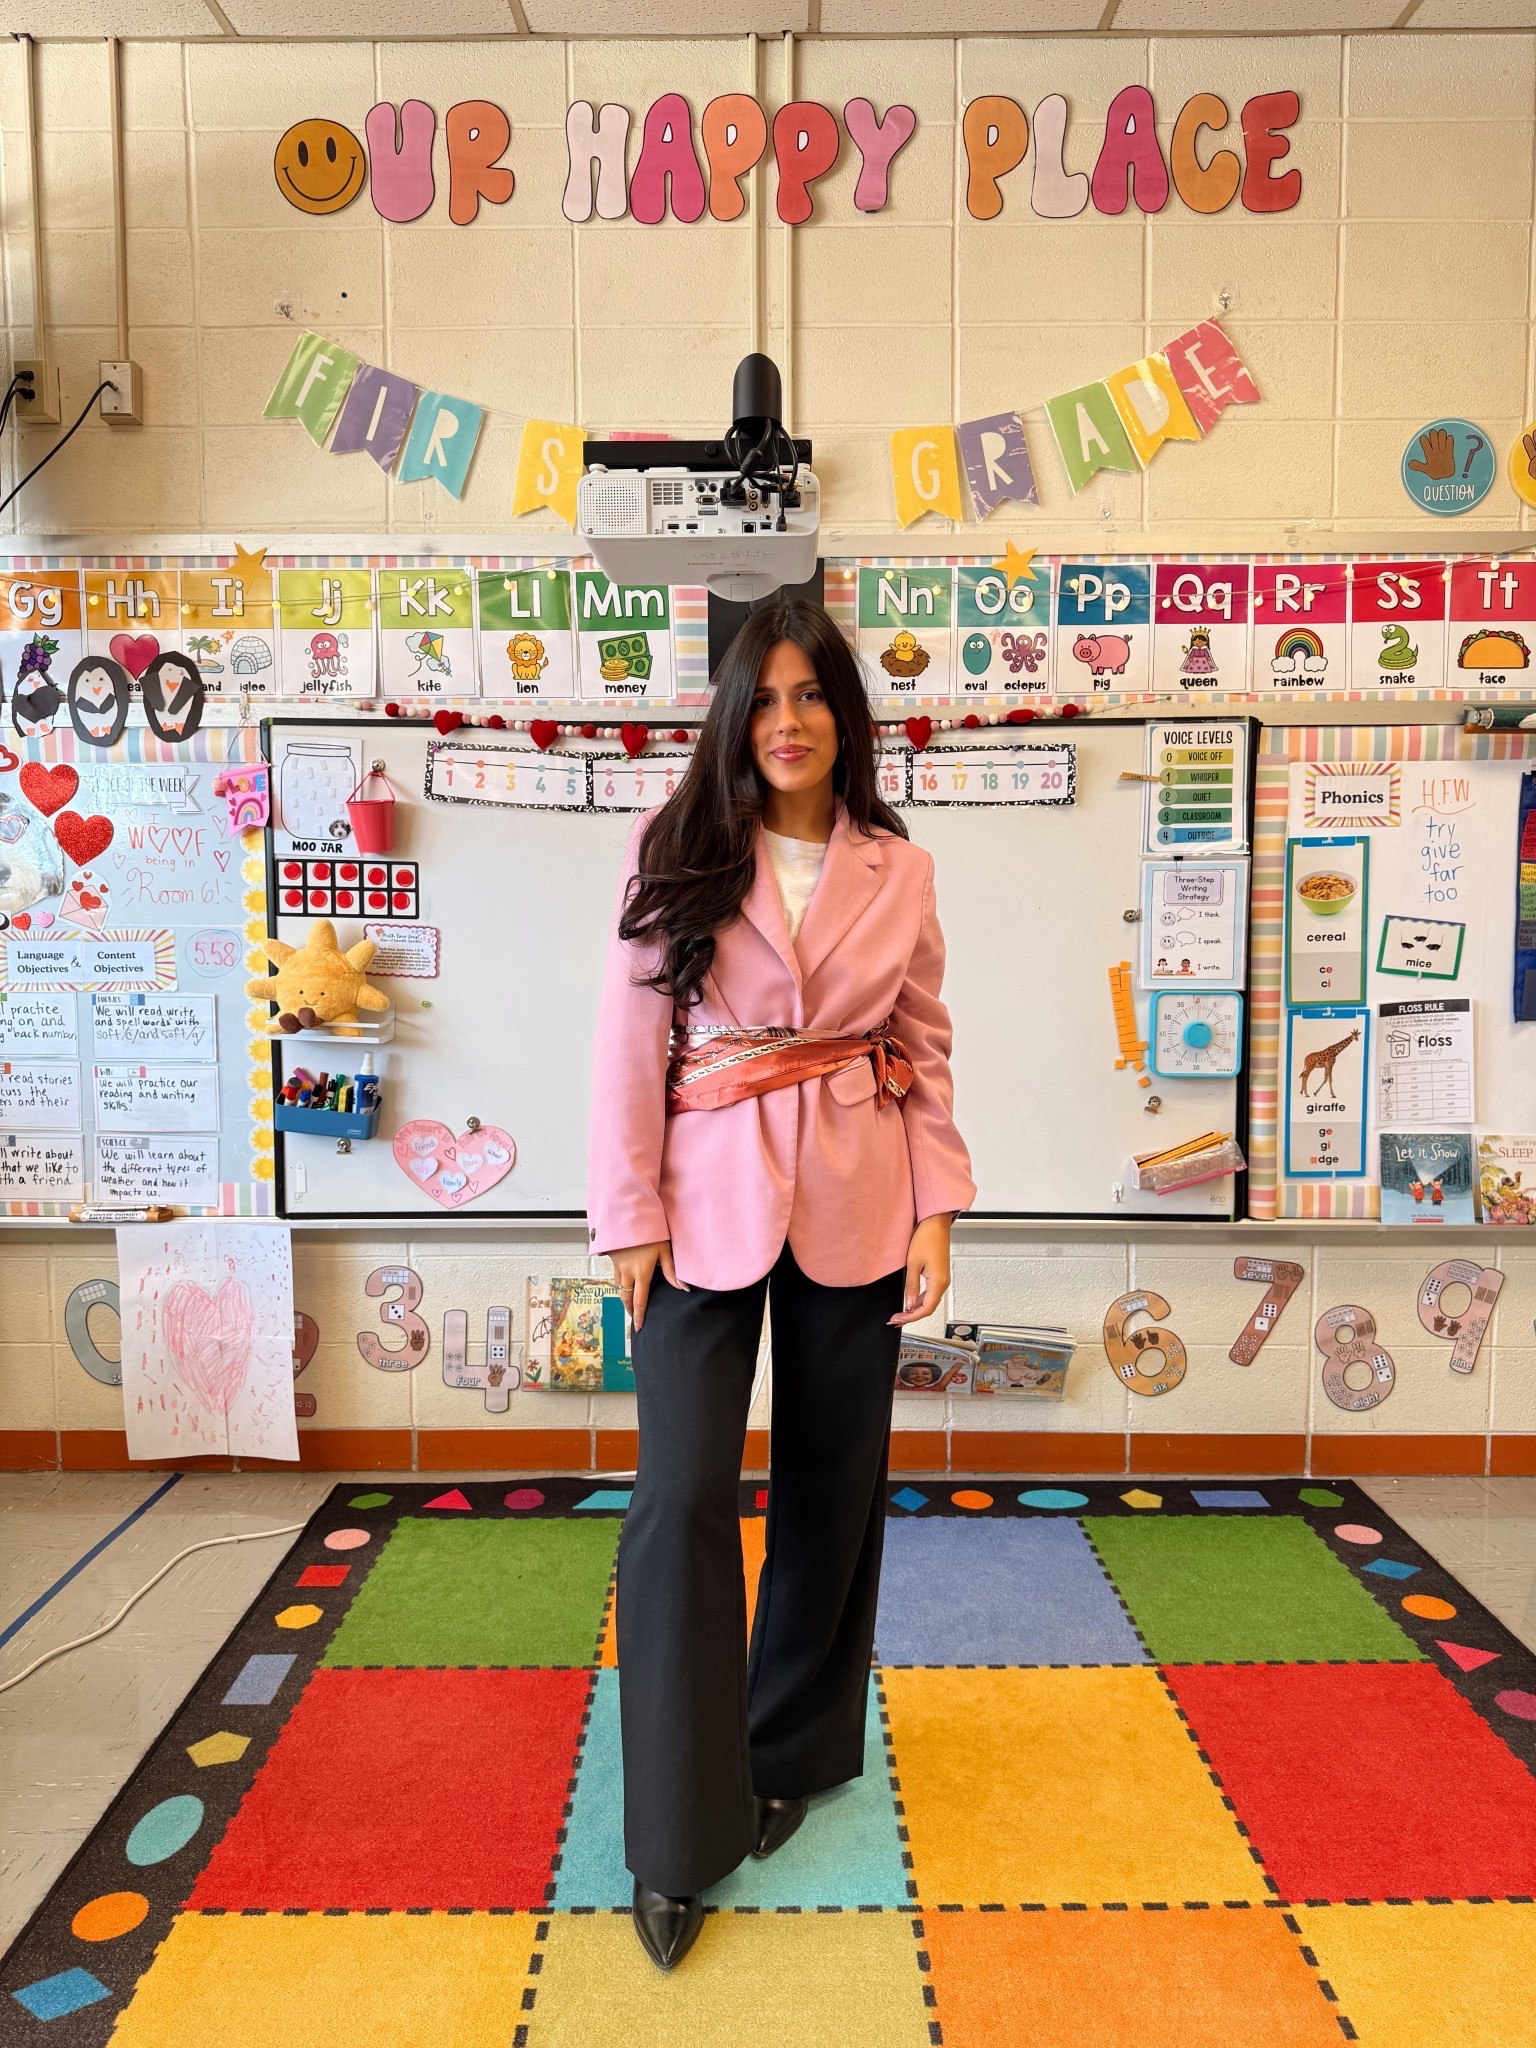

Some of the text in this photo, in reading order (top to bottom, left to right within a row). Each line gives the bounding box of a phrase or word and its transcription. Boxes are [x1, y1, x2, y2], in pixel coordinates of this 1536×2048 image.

[562, 92, 917, 226] HAPPY
[962, 85, 1302, 221] PLACE
[911, 341, 1232, 501] GRADE
[1423, 484, 1475, 501] QUESTION
[399, 577, 455, 617] Kk
[877, 576, 935, 616] Nn
[974, 575, 1035, 616] Oo
[1171, 573, 1233, 621] Qq
[1274, 573, 1327, 613] Rr
[1376, 571, 1423, 610] Ss
[1477, 571, 1519, 610] Tt
[8, 581, 63, 627] Gg
[106, 580, 161, 618] Hh
[211, 578, 244, 617] Ii
[312, 578, 343, 626] Jj
[510, 579, 542, 619] Ll
[583, 579, 665, 619] Mm
[1076, 573, 1132, 622] Pp
[891, 679, 917, 691] nest
[1093, 678, 1111, 691] pig
[1179, 676, 1218, 689] queen
[1273, 675, 1325, 687] rainbow
[1379, 673, 1416, 685] snake
[1479, 672, 1506, 685] taco
[239, 681, 266, 693] igloo
[300, 681, 353, 694] jellyfish
[417, 680, 442, 692] kite
[516, 681, 539, 694] lion
[604, 683, 647, 696] money
[964, 680, 1047, 692] oval octopus
[1164, 730, 1233, 744] VOICE LEVELS
[1188, 751, 1223, 761] VOICE OFF
[446, 770, 577, 795] 1 2 3 4 5
[881, 775, 899, 792] 15
[920, 771, 1063, 791] 16 17 18 19 20
[1190, 772, 1220, 782] WHISPER
[159, 777, 185, 793] WEEK
[226, 774, 267, 794] LOVE
[604, 780, 675, 797] 6 7 8
[1192, 793, 1212, 801] QUIET
[1321, 791, 1384, 805] Phonics
[1182, 812, 1222, 820] CLASSROOM
[1426, 816, 1456, 839] try
[1187, 831, 1215, 840] OUTSIDE
[292, 841, 343, 854] MOO JAR
[1421, 841, 1461, 871] give
[146, 856, 195, 873] being in
[1429, 863, 1465, 883] far
[127, 867, 194, 904] Room
[1173, 876, 1215, 884] Three-Step
[1180, 884, 1208, 893] Writing
[1424, 884, 1458, 903] too
[1177, 893, 1210, 902] Strategy
[1203, 938, 1222, 946] speak.
[1306, 931, 1346, 942] cereal
[17, 951, 65, 961] Language
[97, 951, 137, 960] Content
[194, 941, 236, 967] 5.58
[17, 963, 69, 974] Objectives
[93, 963, 144, 974] Objectives
[1406, 958, 1432, 968] mice
[1319, 966, 1333, 974] ce
[1321, 979, 1331, 988] ci
[11, 1002, 59, 1019] practice
[95, 1005, 135, 1016] We will
[1399, 1003, 1445, 1014] FLOSS RULE
[18, 1015, 66, 1027] on and
[95, 1016, 200, 1029] and spell words with
[14, 1029, 40, 1038] back
[97, 1028, 121, 1040] soft
[1417, 1035, 1453, 1048] floss
[9, 1072, 72, 1085] read stories
[139, 1077, 176, 1090] practice
[30, 1086, 47, 1097] the
[99, 1088, 195, 1103] reading and writing
[18, 1097, 36, 1106] and
[40, 1096, 70, 1107] their
[1306, 1103, 1346, 1114] giraffe
[412, 1122, 443, 1133] heart
[1319, 1128, 1333, 1137] ge
[11, 1145, 74, 1160] write about
[1320, 1142, 1331, 1152] gi
[1395, 1143, 1457, 1162] Let Snow
[1499, 1147, 1533, 1158] SLEEP
[101, 1149, 206, 1161] We will learn about
[1, 1160, 63, 1173] that like
[102, 1161, 190, 1175] the different types
[32, 1172, 73, 1186] friend
[101, 1175, 176, 1187] weather and how
[146, 1189, 161, 1197] us.
[1242, 1270, 1274, 1282] seven
[357, 1265, 431, 1372] 3
[1103, 1290, 1187, 1396] 6
[378, 1356, 409, 1369] three
[443, 1306, 521, 1413] 4
[1450, 1357, 1474, 1370] nine
[456, 1375, 482, 1387] four
[1153, 1381, 1169, 1394] six
[1353, 1392, 1380, 1409] eight
